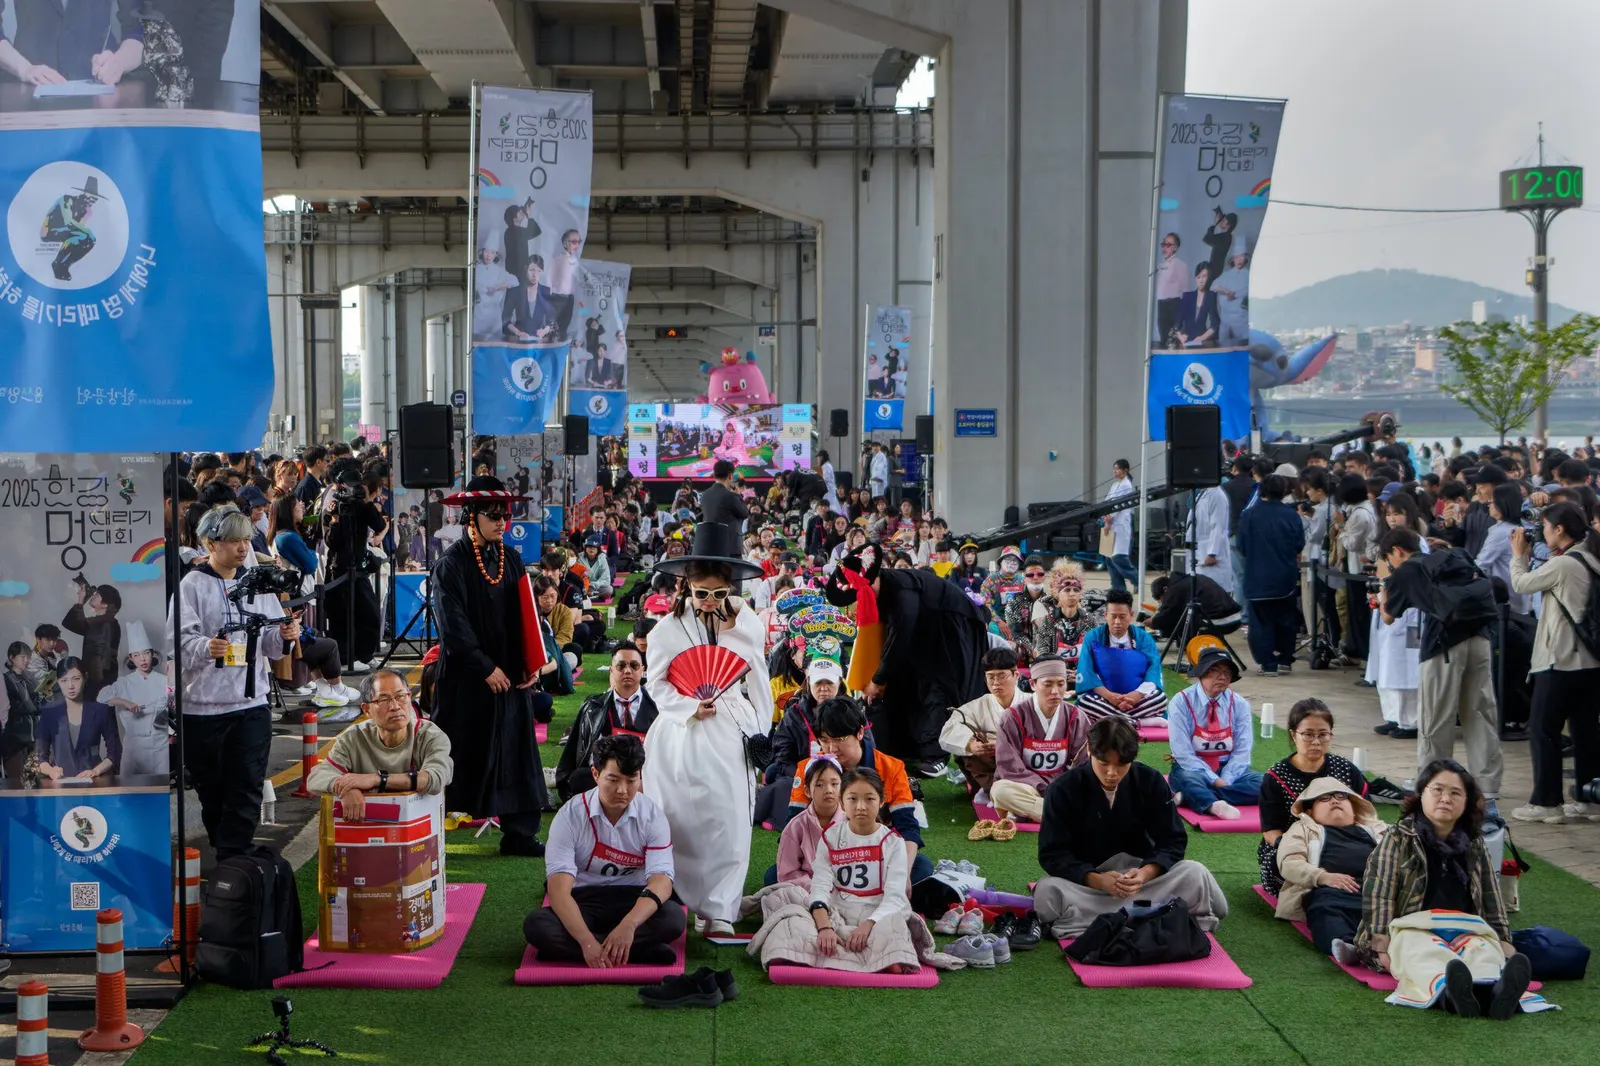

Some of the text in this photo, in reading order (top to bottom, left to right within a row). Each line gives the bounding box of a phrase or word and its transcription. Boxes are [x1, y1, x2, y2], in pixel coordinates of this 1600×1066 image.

[1171, 113, 1242, 145] 2025 한강
[1197, 147, 1268, 198] 멍 때리기
[1227, 159, 1254, 172] 대회
[1508, 169, 1582, 201] 12:00
[2, 464, 109, 507] 2025 한강
[45, 510, 152, 571] 멍 때리기
[89, 528, 133, 545] 대회
[803, 621, 855, 637] 1668-0120
[1030, 752, 1059, 770] 09
[837, 863, 869, 889] 03
